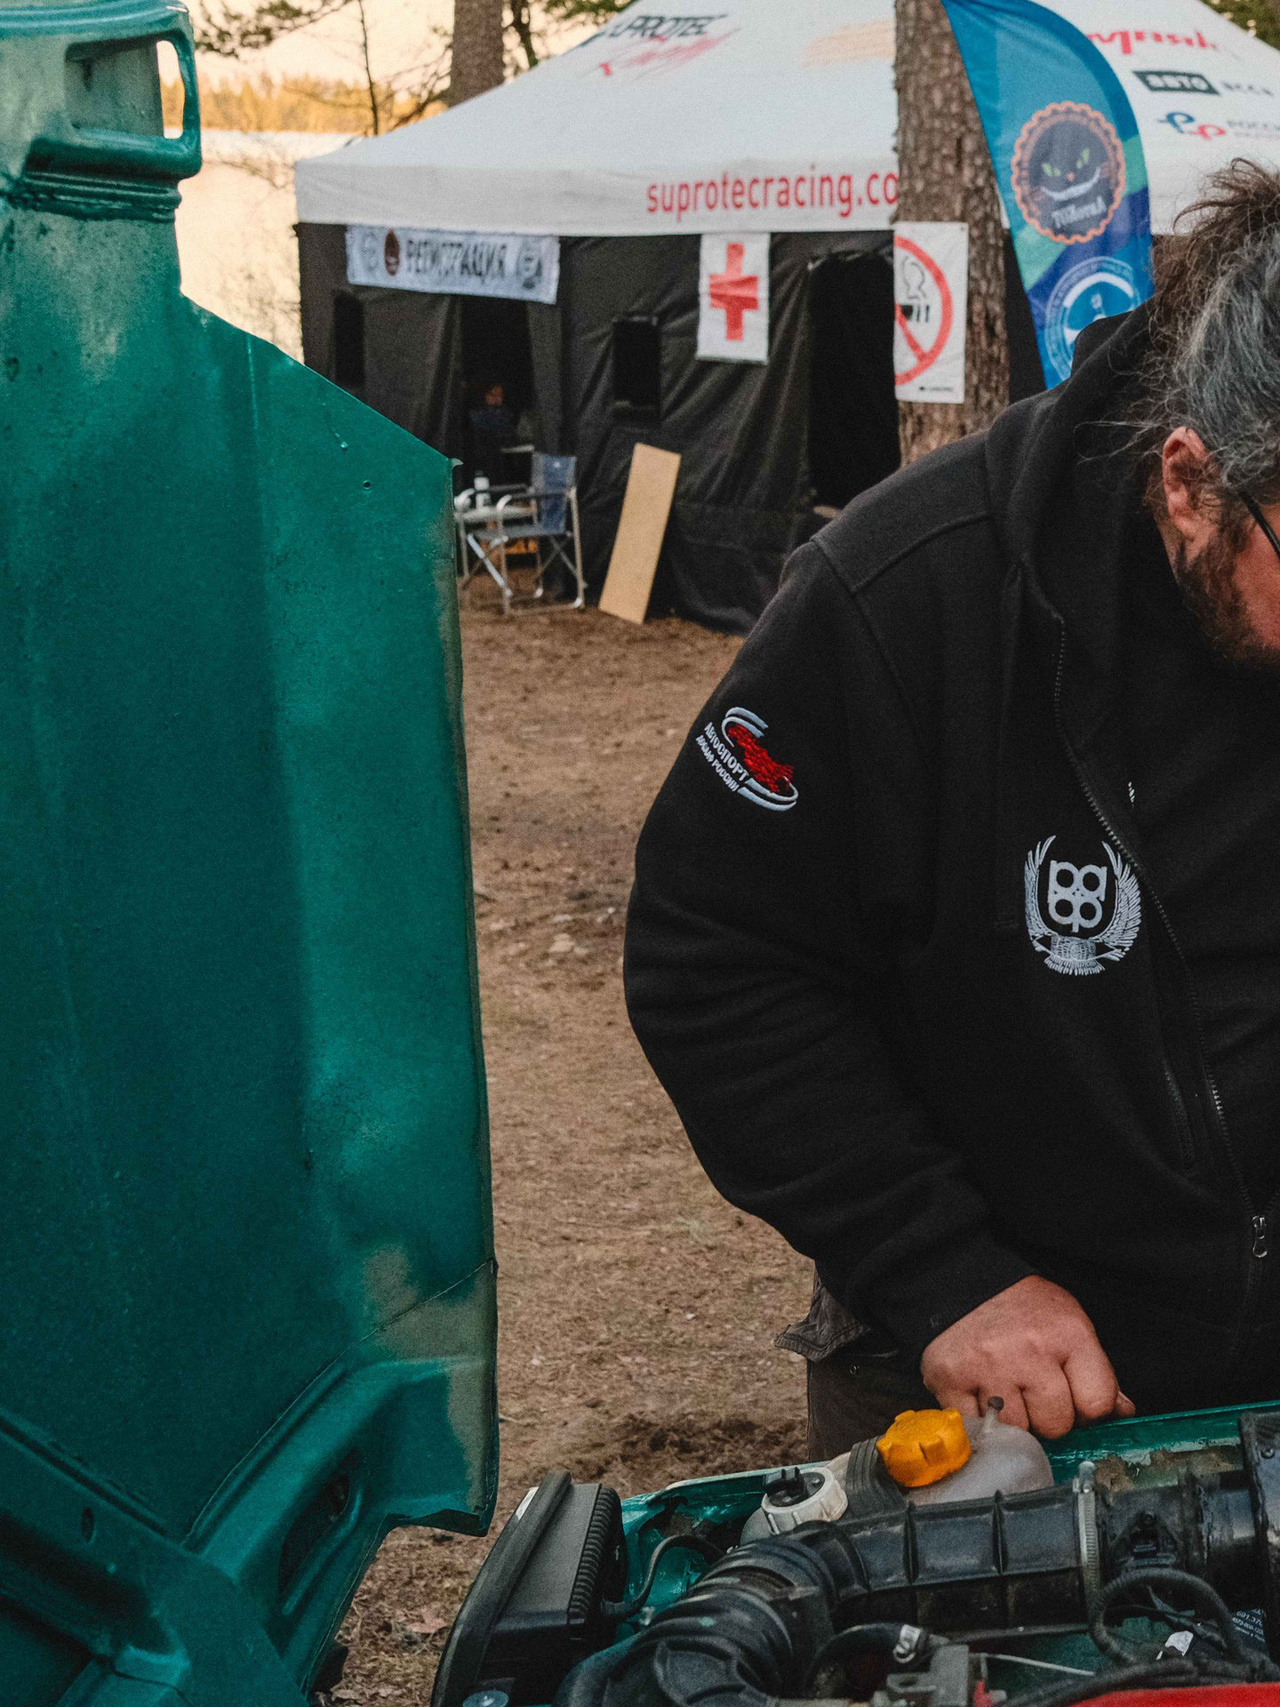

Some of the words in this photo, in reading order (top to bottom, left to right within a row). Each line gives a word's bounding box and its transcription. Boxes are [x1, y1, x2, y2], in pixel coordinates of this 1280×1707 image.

[647, 164, 898, 223] suprotecracing.co
[704, 721, 750, 782] АВТОСПОРТ
[711, 758, 740, 792] РОССИИ
